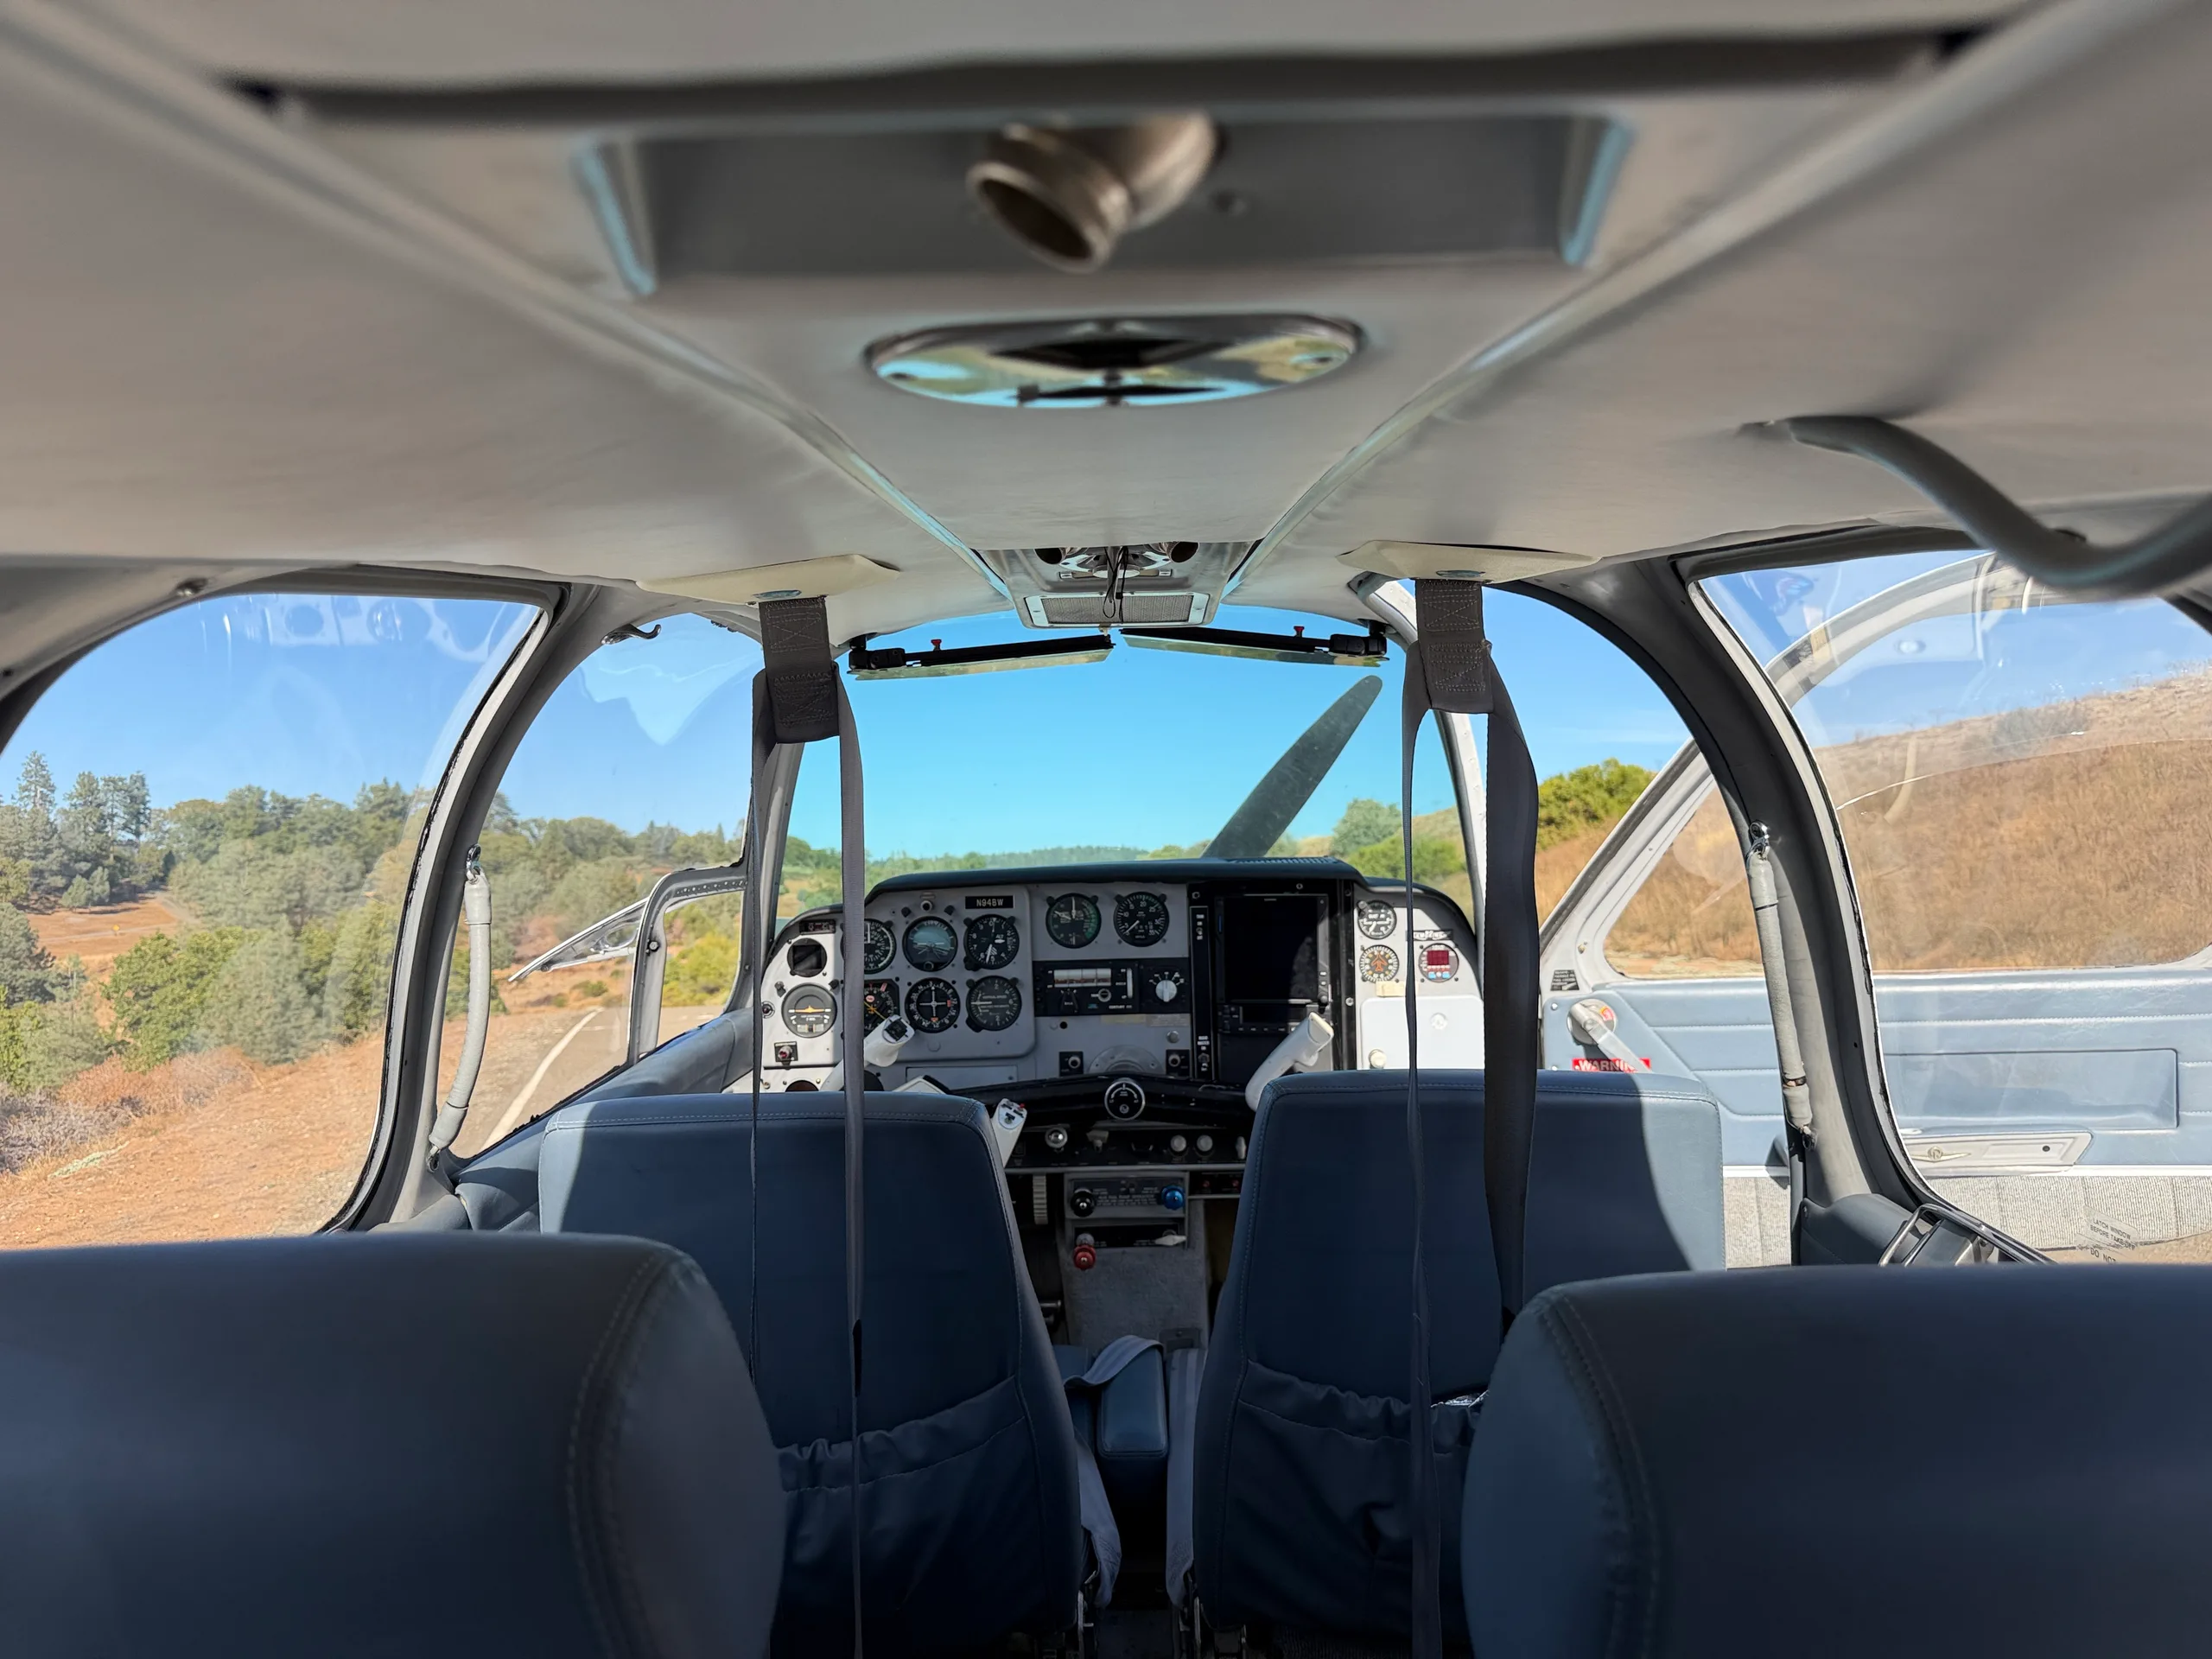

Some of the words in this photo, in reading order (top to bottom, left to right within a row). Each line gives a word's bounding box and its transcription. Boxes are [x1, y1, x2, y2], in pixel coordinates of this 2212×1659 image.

[1578, 1058, 1637, 1071] WARNIN
[2090, 1224, 2110, 1238] BEFORE
[2090, 1247, 2100, 1258] DO
